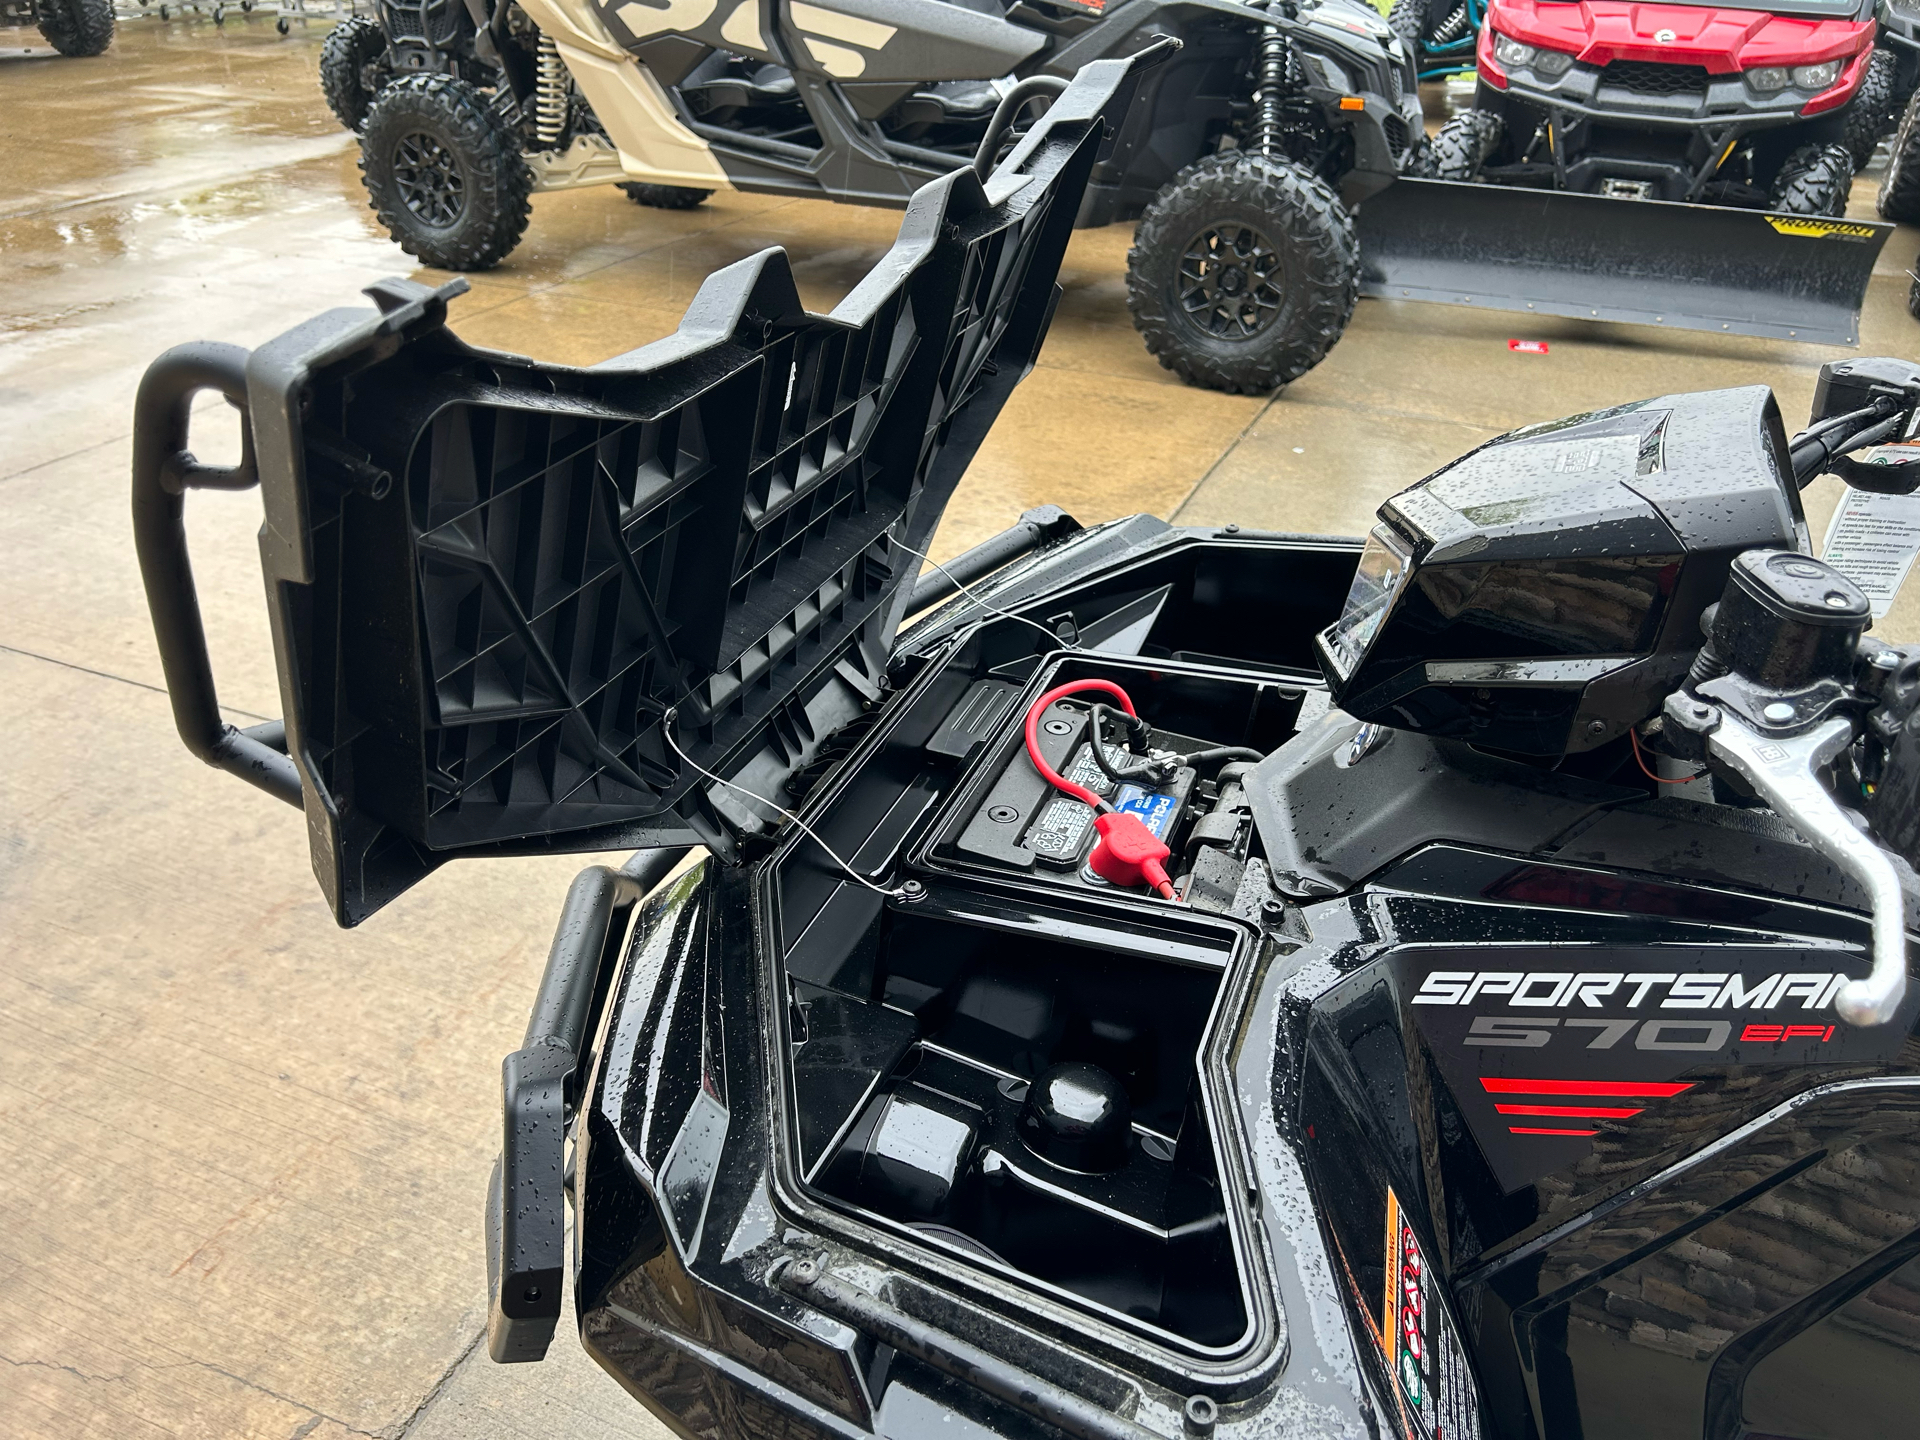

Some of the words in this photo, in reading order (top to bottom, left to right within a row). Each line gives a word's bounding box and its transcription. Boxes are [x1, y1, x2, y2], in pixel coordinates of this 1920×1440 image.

[1771, 217, 1874, 236] PROMOUNT
[1146, 797, 1170, 834] POLAR
[1463, 1016, 1732, 1051] 570
[1740, 1024, 1835, 1042] EFI
